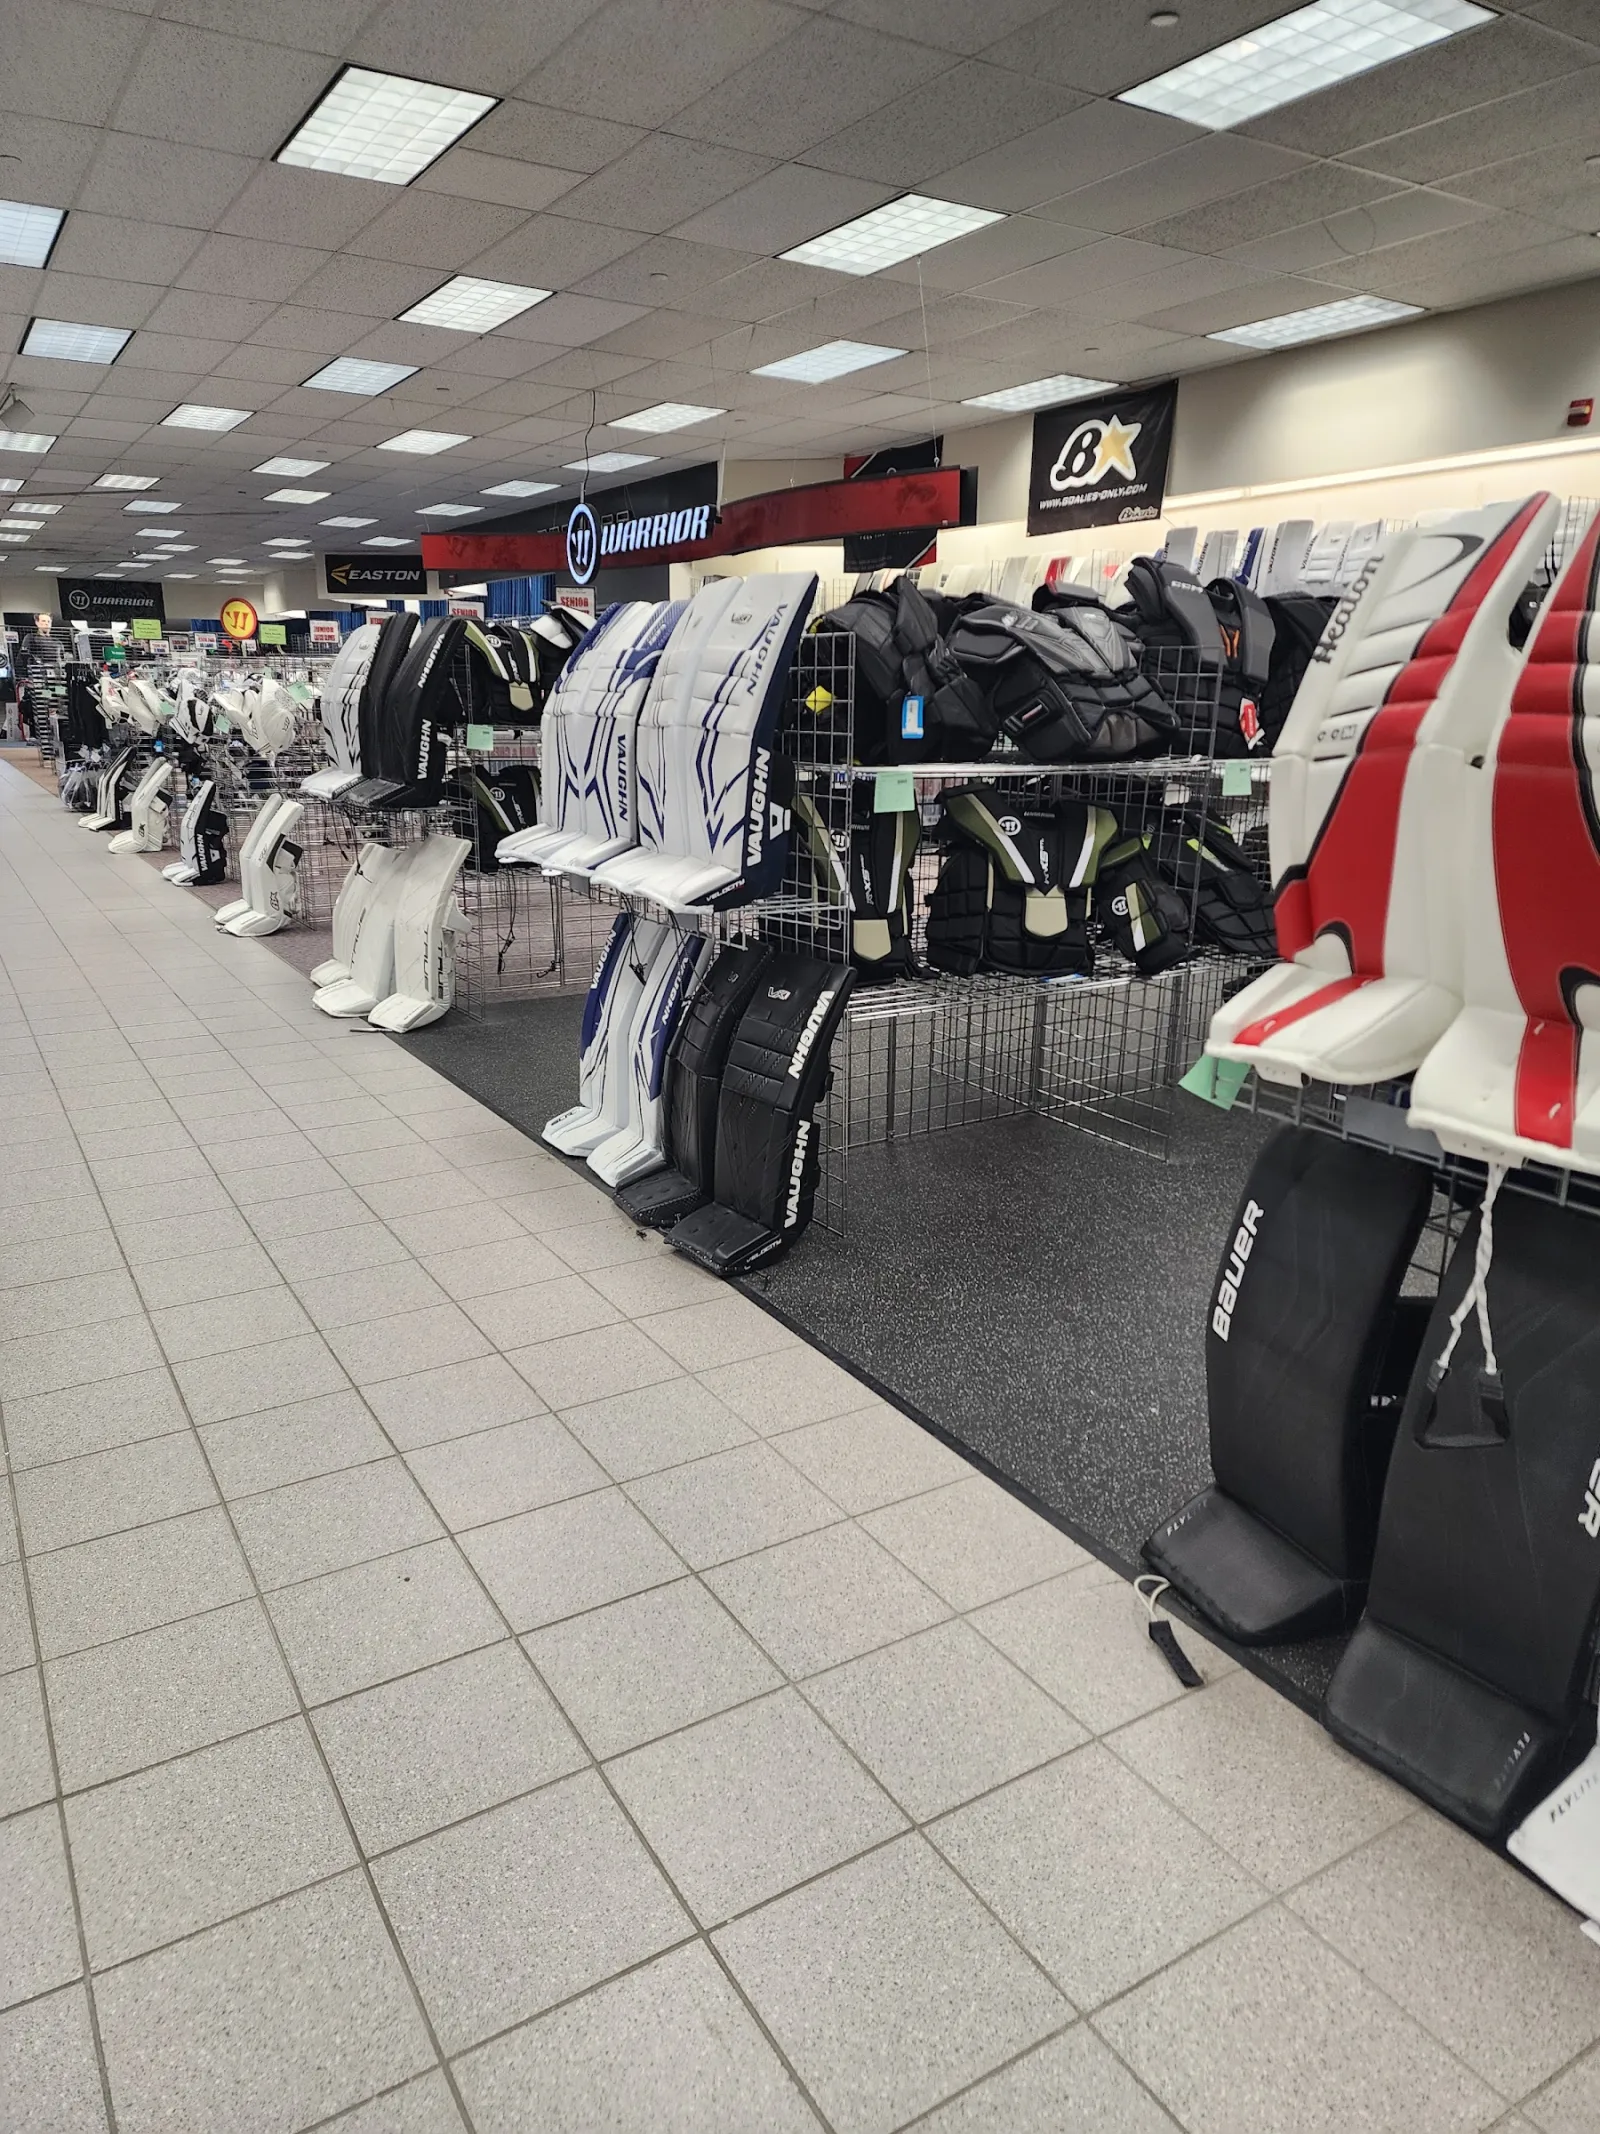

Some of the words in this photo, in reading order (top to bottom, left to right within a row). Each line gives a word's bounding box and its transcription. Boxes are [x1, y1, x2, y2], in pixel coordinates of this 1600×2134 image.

[600, 504, 710, 556] WARRIOR
[92, 596, 155, 607] WARRIOR
[348, 569, 421, 581] EASTON
[560, 596, 589, 607] SENIOR
[417, 632, 446, 689] VAUGHN
[746, 602, 789, 697] VAUGHN
[416, 718, 433, 780] VAUGHN
[616, 733, 630, 823] VAUGHN
[746, 745, 772, 867] VAUGHN
[196, 833, 209, 872] VAUGHN
[706, 878, 746, 902] VELOCITY
[590, 929, 617, 990] VAUGHN
[661, 957, 689, 1026] VAUGHN
[787, 990, 836, 1080] VAUGHN
[783, 1119, 811, 1229] VAUGHN
[1211, 1199, 1265, 1342] BAUER
